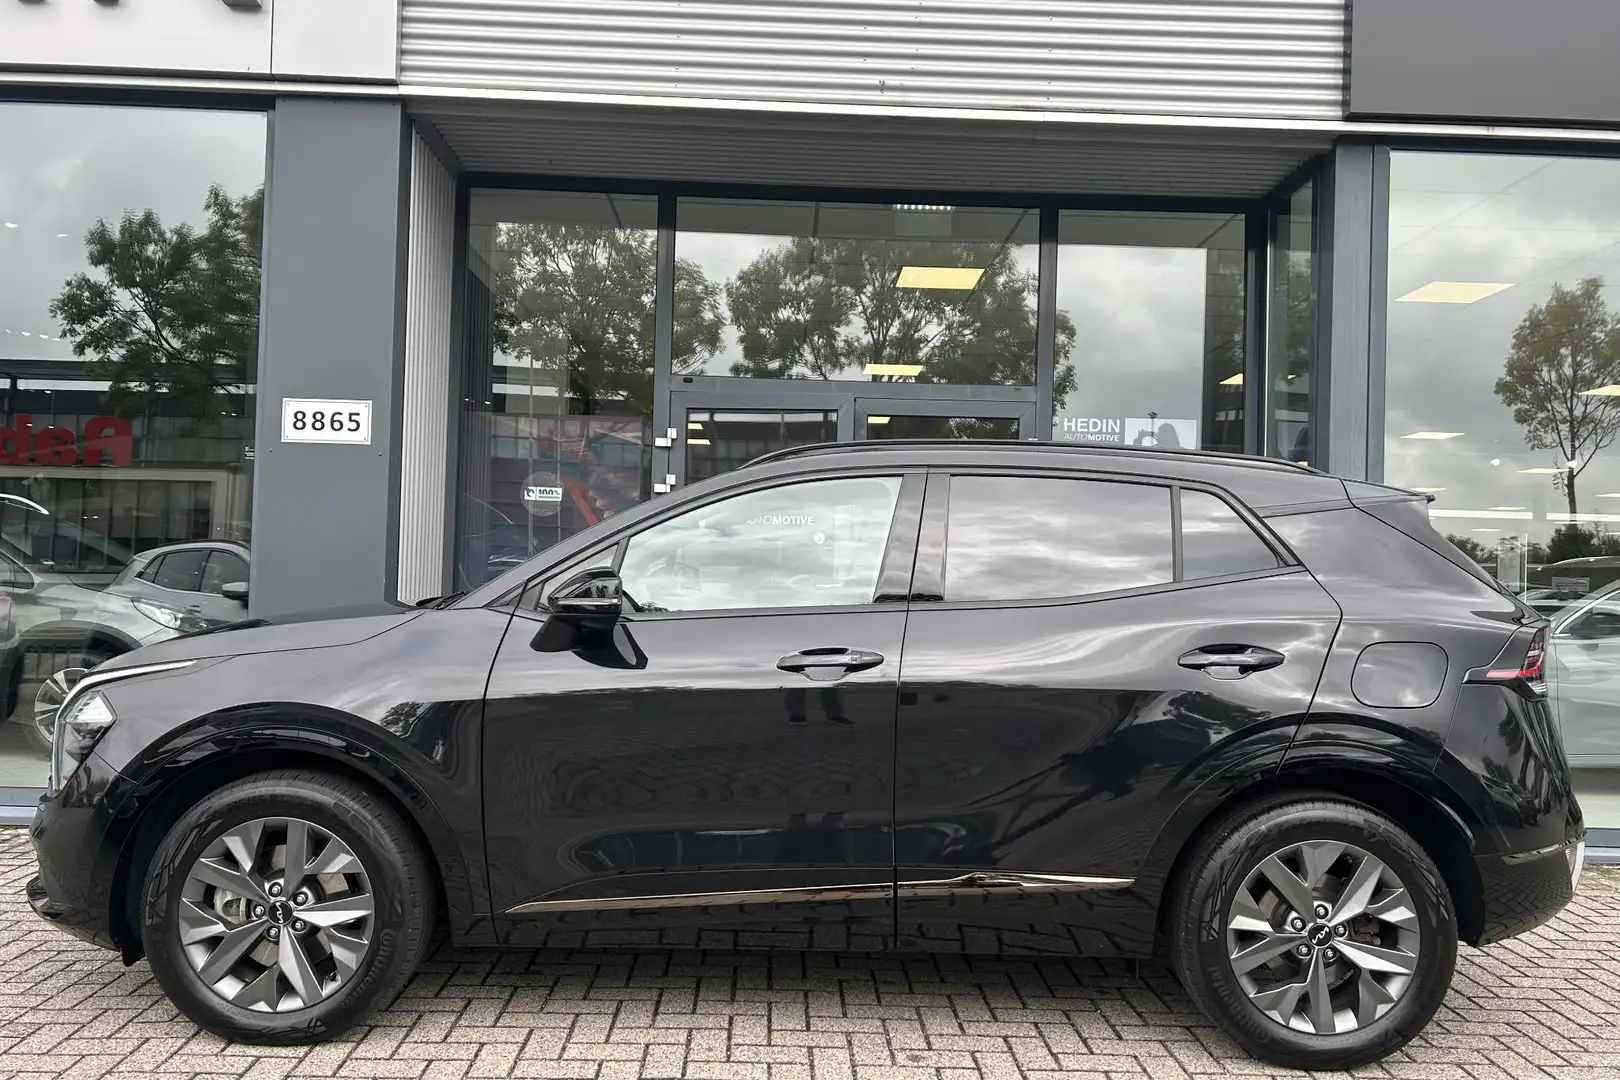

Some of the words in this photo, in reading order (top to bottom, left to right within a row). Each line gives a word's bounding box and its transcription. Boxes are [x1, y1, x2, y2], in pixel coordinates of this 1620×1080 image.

[292, 410, 361, 432] 8865
[1063, 417, 1120, 433] HEDIN
[1063, 433, 1120, 442] AUTOMOTIVE
